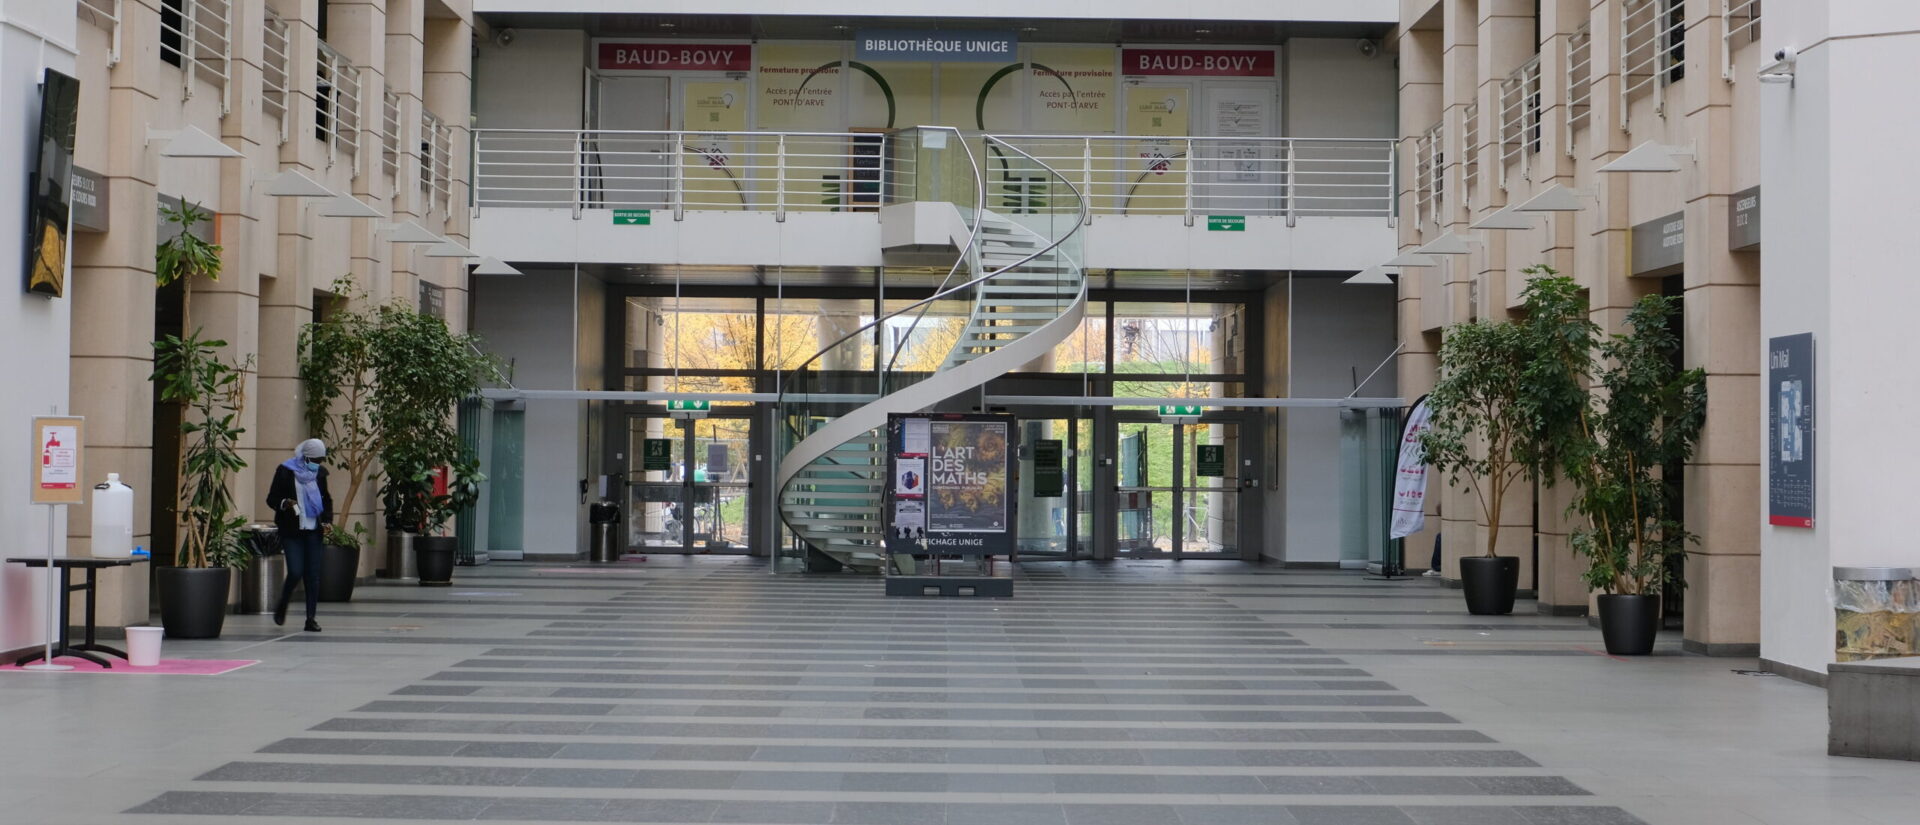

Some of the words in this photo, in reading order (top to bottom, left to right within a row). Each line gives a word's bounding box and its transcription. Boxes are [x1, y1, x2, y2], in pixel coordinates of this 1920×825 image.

[865, 38, 962, 53] BIBLIOTHÈQUE
[966, 41, 1008, 53] UNIGE
[616, 49, 733, 64] BAUD-BOVY
[1140, 55, 1256, 71] BAUD-BOVY
[760, 66, 799, 74] Fermeture
[1074, 69, 1113, 78] provisoire
[766, 87, 787, 95] Accès
[803, 87, 832, 96] l'entrée
[1040, 90, 1060, 98] Accès
[1077, 90, 1106, 98] l'entrée
[1770, 350, 1779, 369] Uni
[1779, 348, 1789, 368] Mail
[932, 459, 964, 471] DES
[932, 472, 987, 485] MATHS
